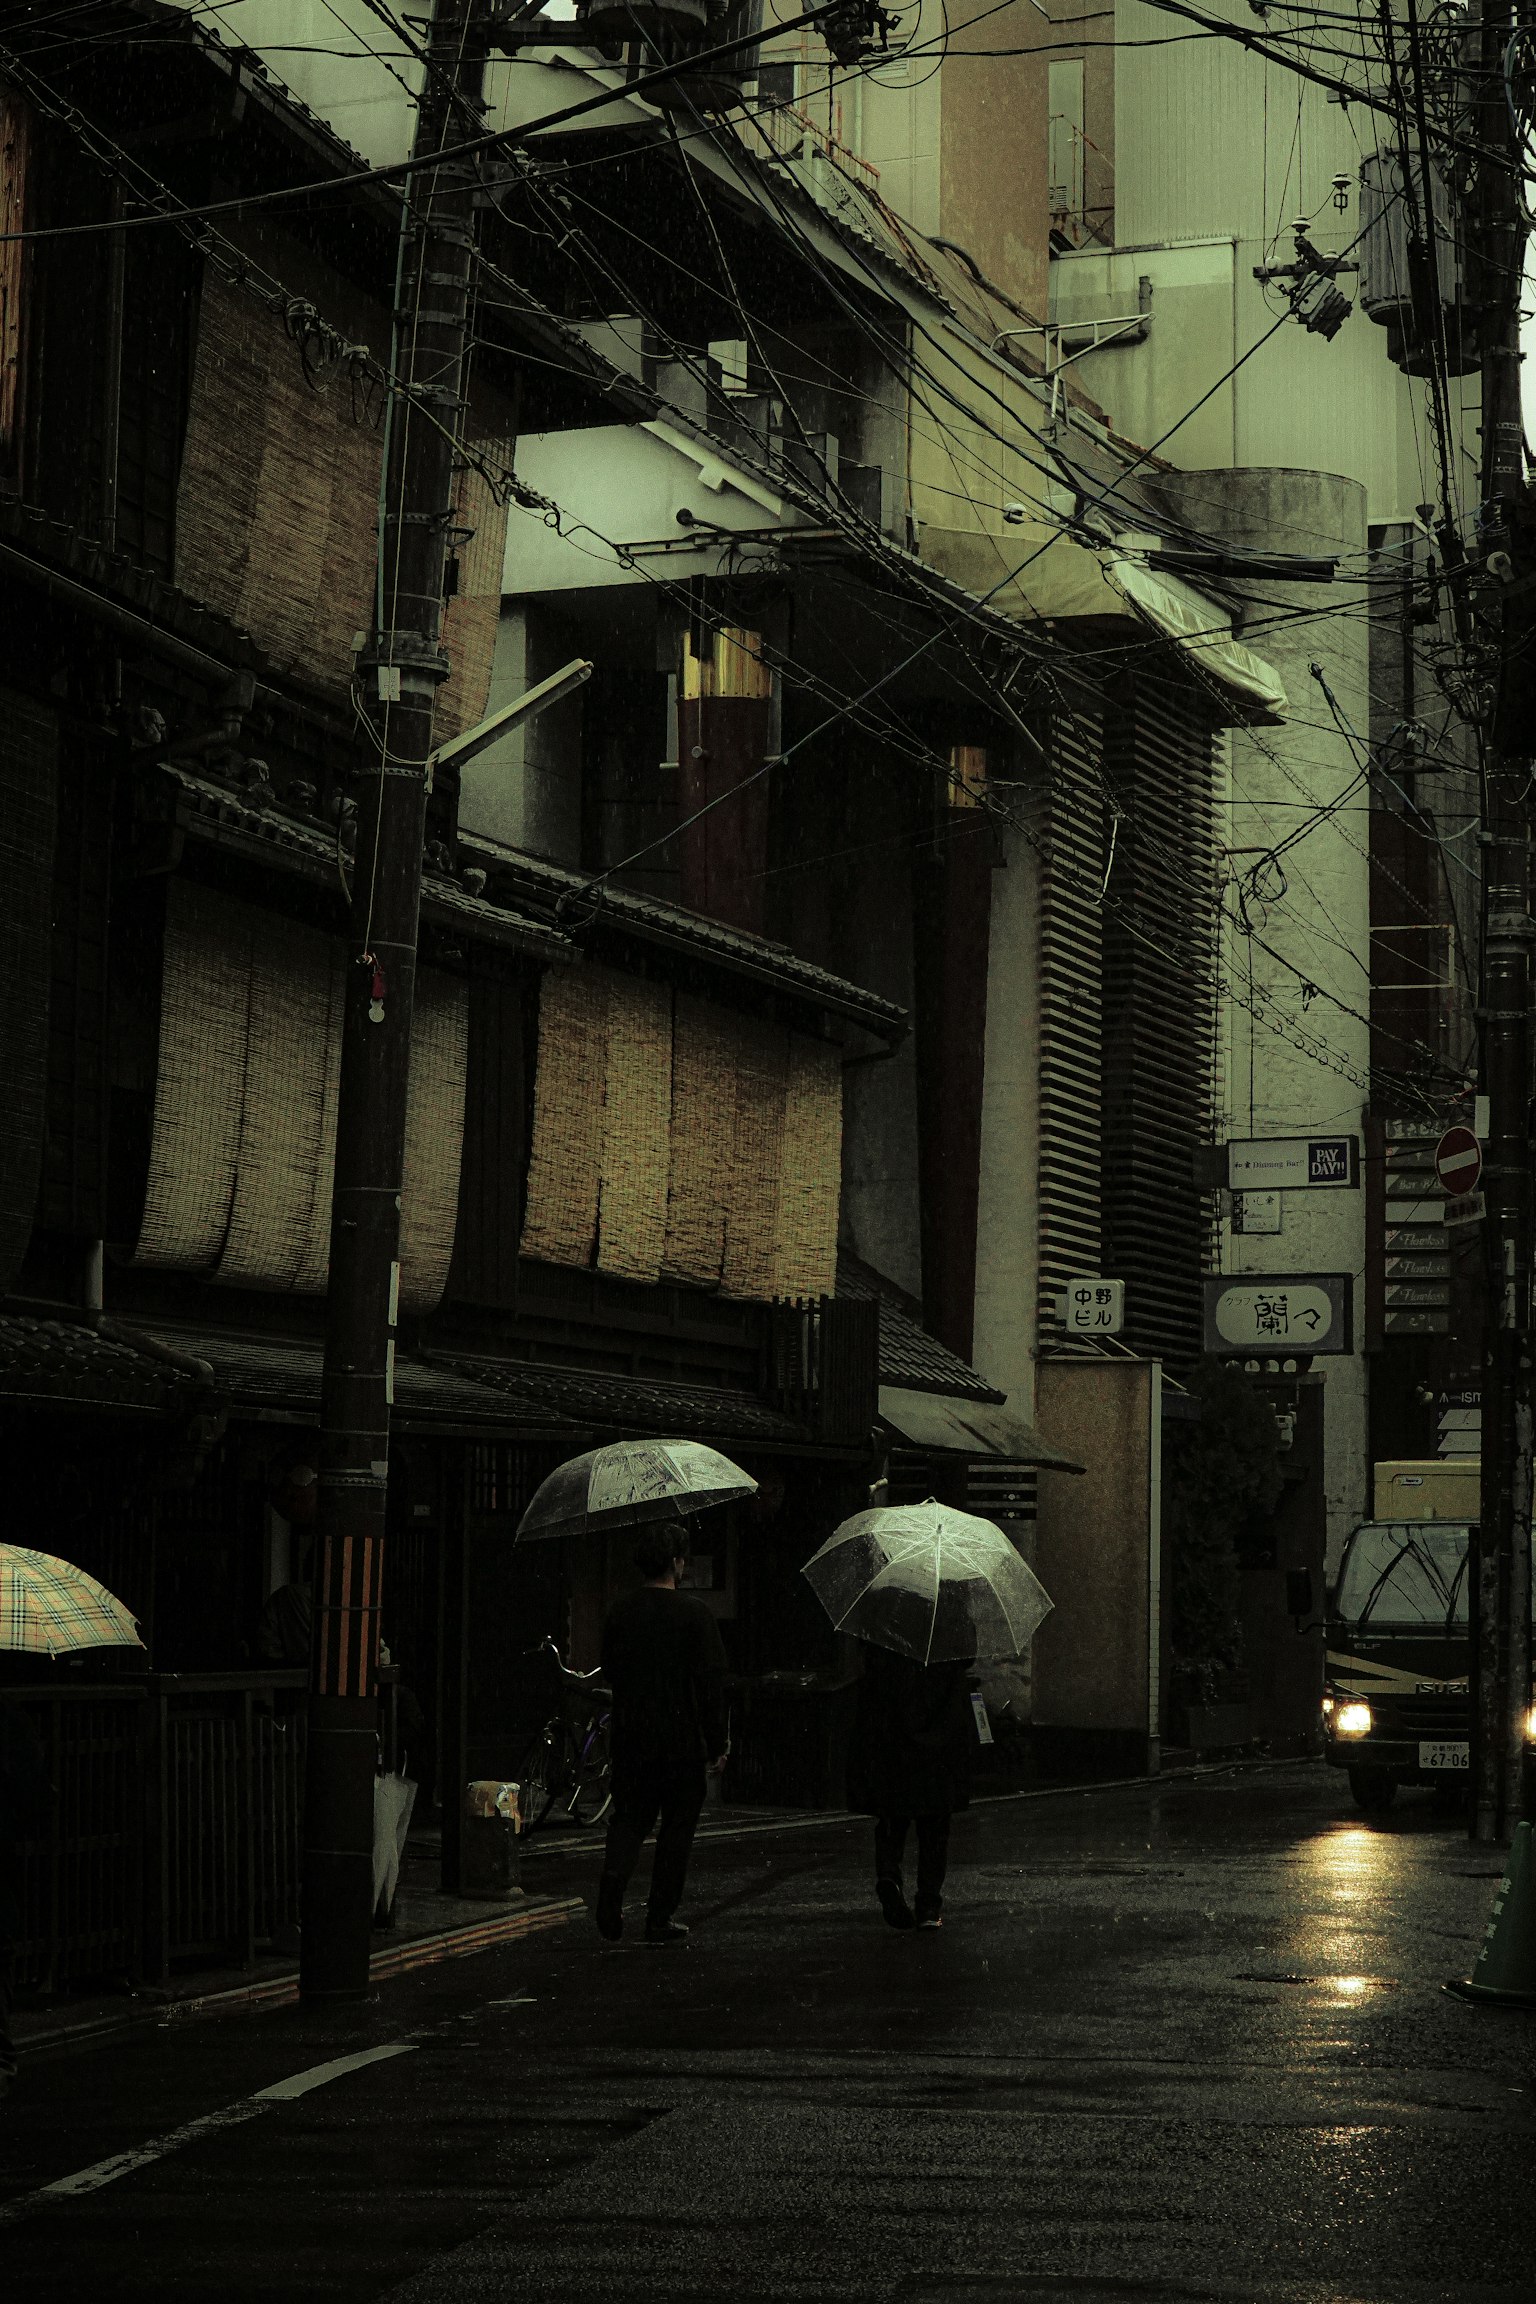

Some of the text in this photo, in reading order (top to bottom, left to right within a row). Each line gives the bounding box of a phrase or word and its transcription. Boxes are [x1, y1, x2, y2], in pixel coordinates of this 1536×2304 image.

[1315, 1148, 1339, 1162] PAY
[1311, 1161, 1345, 1176] DAY!!
[1074, 1287, 1112, 1306] 中野
[1074, 1309, 1112, 1327] ビル
[1430, 1753, 1468, 1767] 67-06
